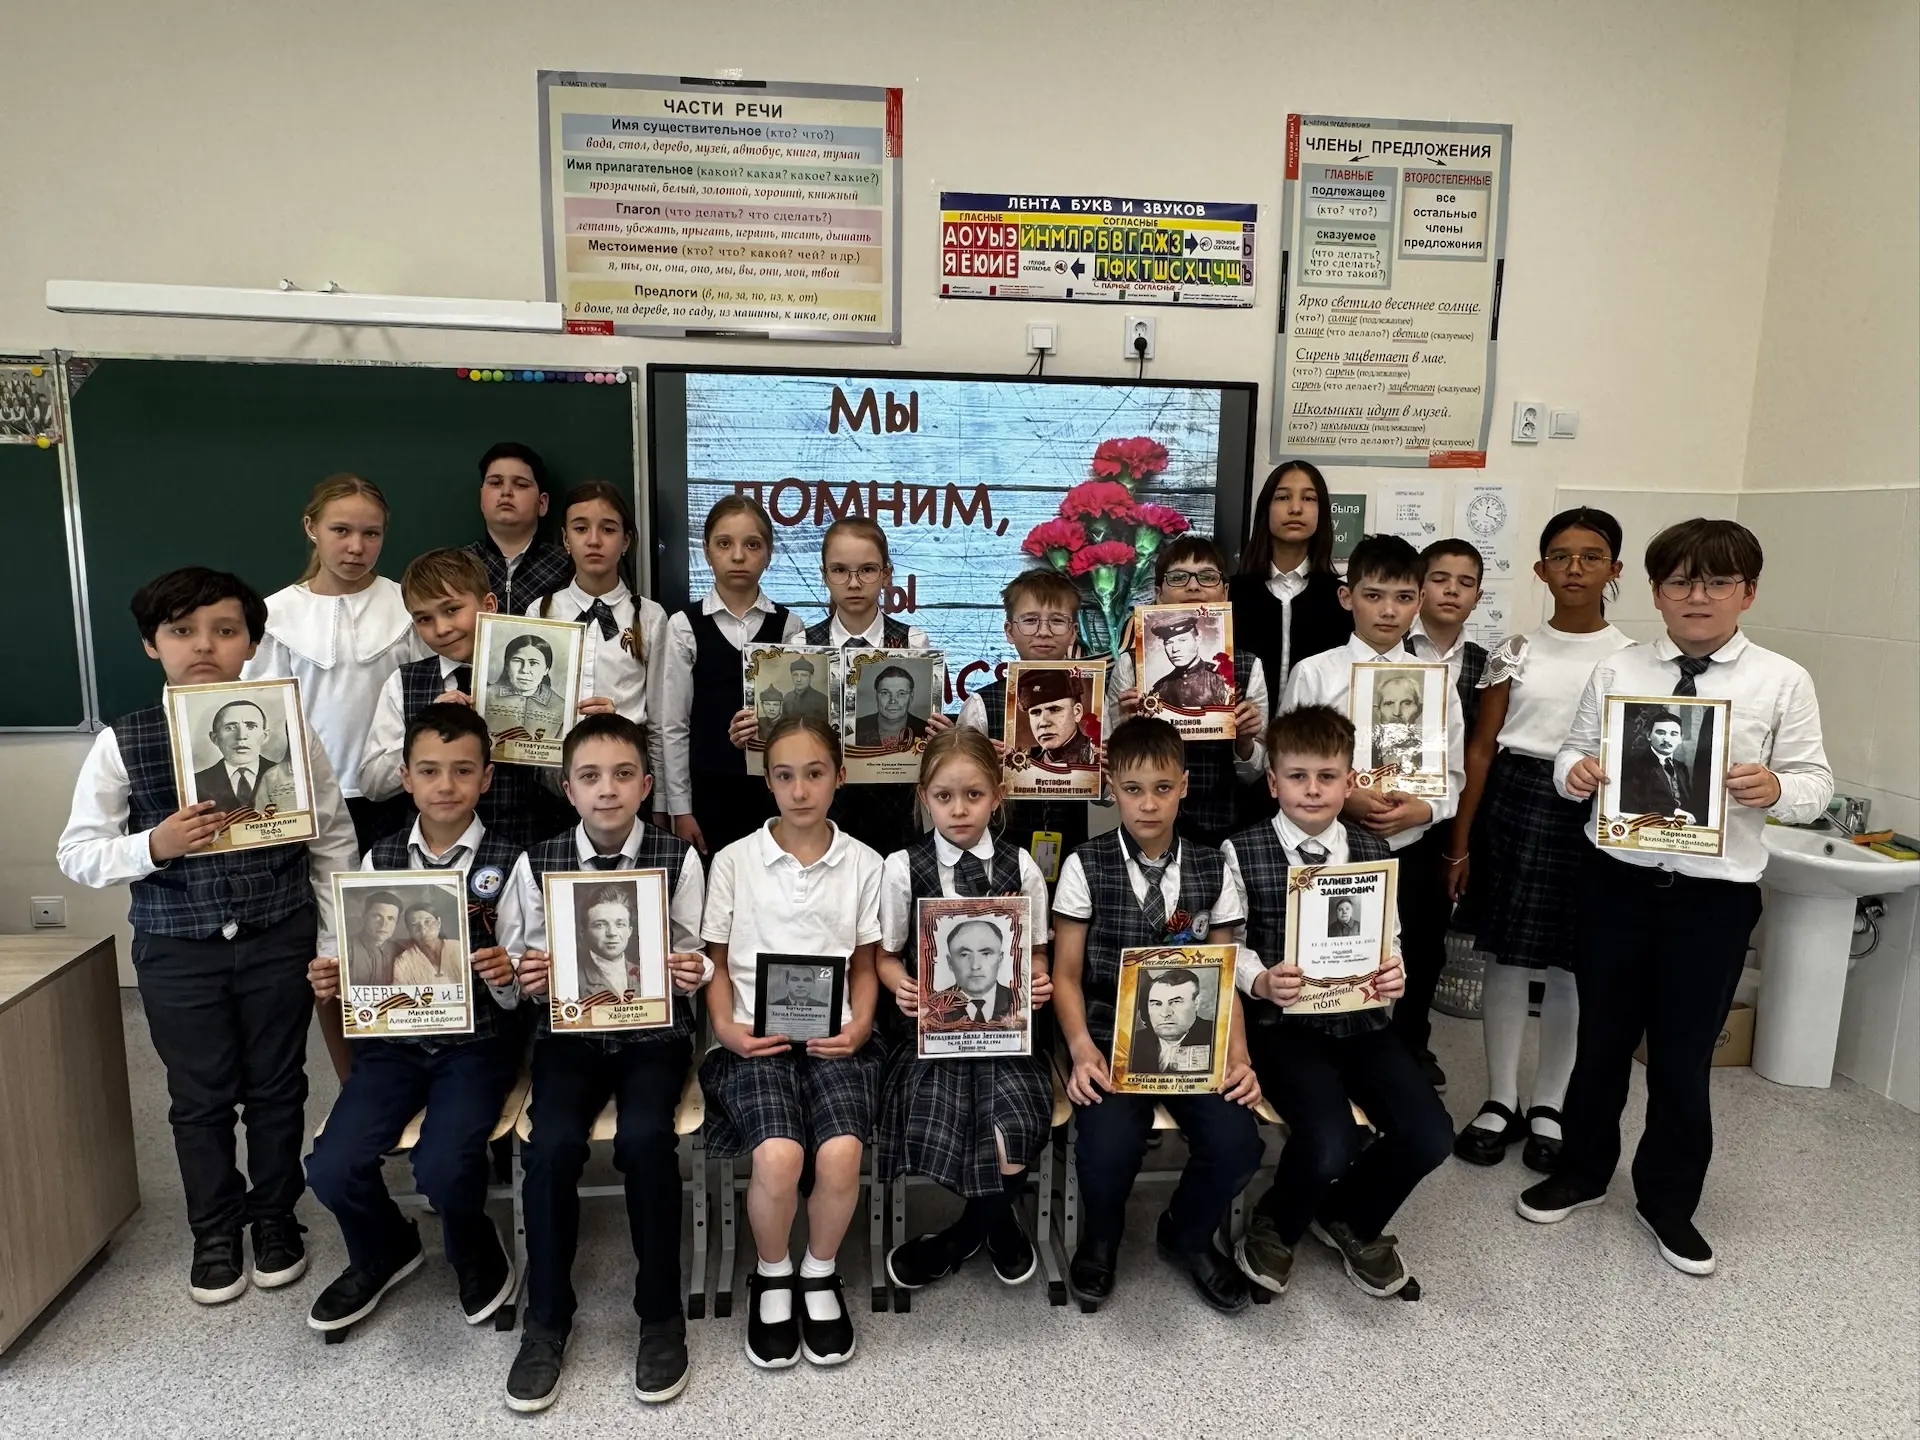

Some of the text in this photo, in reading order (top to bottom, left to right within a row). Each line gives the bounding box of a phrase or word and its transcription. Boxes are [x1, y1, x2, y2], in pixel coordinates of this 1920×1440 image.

[664, 100, 783, 118] ЧАСТИ РЕЧИ
[612, 119, 834, 142] Имя существительное (кто? что?)
[586, 137, 860, 161] вода, стол, дерево, музей, автобус, книга, туман
[1306, 138, 1491, 158] ЧЛЕНЫ ПРЕДЛОЖЕНИЯ
[567, 159, 879, 185] Имя прилагательное (какой? какая? какое? какие?)
[1325, 169, 1373, 181] ГЛАВНЫЕ
[1405, 172, 1491, 185] ВТОРОСТЕПЕННЫЕ
[589, 179, 858, 201] прозрачный, белый, золотой, хороший, книжный
[1312, 186, 1385, 198] подлежащее
[1437, 194, 1455, 203] все
[1008, 198, 1206, 216] ЛЕНТА БУКВ И ЗВУКОВ
[1317, 205, 1377, 217] (кто? что?)
[616, 203, 832, 224] Глагол (что делать? что сделать?)
[960, 213, 1003, 222] ГЛАСНЫЕ
[1414, 209, 1477, 219] остальные
[1104, 217, 1158, 227] СОГЛАСНЫЕ
[576, 223, 871, 243] летать, убежать, прыгать, играть, писать, дышать
[1425, 224, 1462, 233] члены
[1317, 230, 1376, 241] сказуемое
[1405, 239, 1482, 250] предложения
[589, 240, 860, 263] Местоимение (кто? что? какой? чей? др.)
[1312, 248, 1380, 260] (что делать?
[608, 262, 618, 272] я,
[621, 262, 642, 272] ты,
[645, 263, 661, 273] он,
[665, 264, 687, 274] она,
[690, 265, 712, 275] оно,
[716, 266, 735, 276] мы,
[739, 265, 756, 276] вы,
[759, 267, 781, 277] они,
[812, 266, 840, 278] твой
[1310, 259, 1380, 269] что сделать?
[1326, 269, 1343, 277] это
[1346, 270, 1386, 281] такой?)
[1101, 282, 1175, 291] ПАРНЫЕ СОГЛАСНЫЕ
[635, 286, 818, 304] Предлоги (в, на, за, по, из, от)
[1298, 294, 1481, 313] Ярко светило весеннее солнце.
[584, 303, 876, 322] доме, на дереве, по саду, из машины, школе, от окна
[1295, 314, 1413, 326] (что?) солнце (подлежащее)
[1294, 327, 1474, 341] солнце (что делало?) светило (сказуемое)
[1296, 348, 1446, 364] Сирень зацветает в мае.
[1293, 367, 1410, 379] (что?) сирень (подлежащее)
[1292, 382, 1480, 394] сирень (что делает?) зацветает (сказуемое)
[1293, 402, 1451, 420] Школьники идут в музей.
[1289, 422, 1425, 433] (кто?) школьники (подлежащее)
[1339, 436, 1357, 446] (что
[1360, 437, 1403, 447] делают?)
[1406, 437, 1430, 447] идут
[1433, 438, 1474, 448] (сказуемое)
[1331, 503, 1360, 513] была
[1661, 830, 1696, 838] Каримов
[1676, 839, 1717, 848] Каримович
[1318, 875, 1378, 885] ГАЛИЕВ ЗАКИ
[1321, 885, 1374, 896] ЗАКИРОВИЧ
